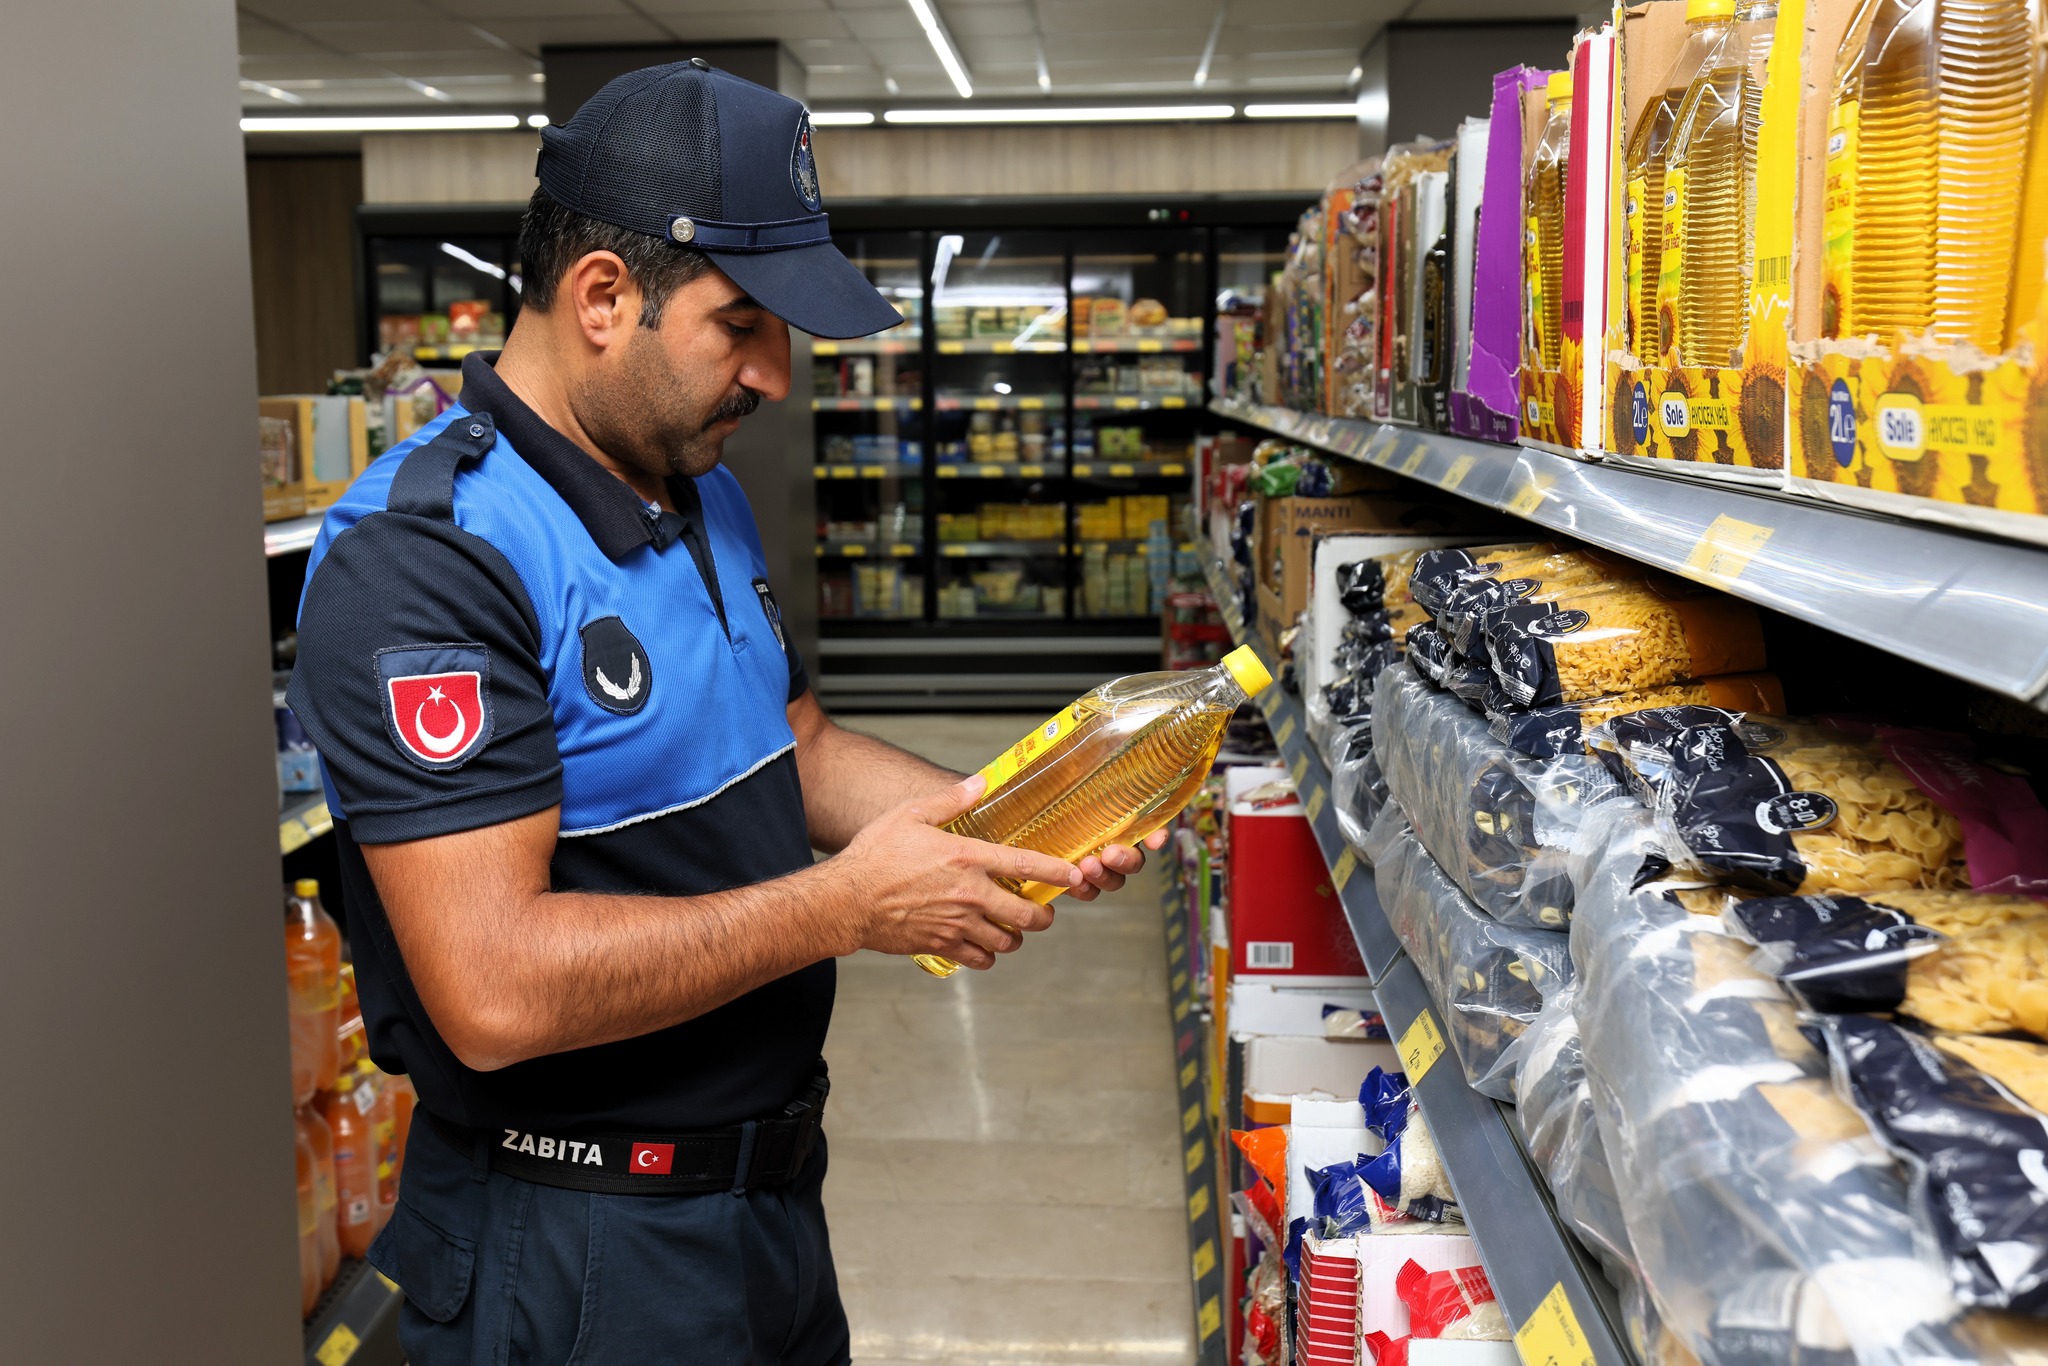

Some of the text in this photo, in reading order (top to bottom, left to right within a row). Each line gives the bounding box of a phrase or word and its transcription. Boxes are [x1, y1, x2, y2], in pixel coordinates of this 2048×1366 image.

[1665, 403, 1684, 426] Sole
[1885, 411, 1915, 443] Sole
[1789, 798, 1819, 823] 8-10
[502, 1129, 603, 1166] ZABITA
